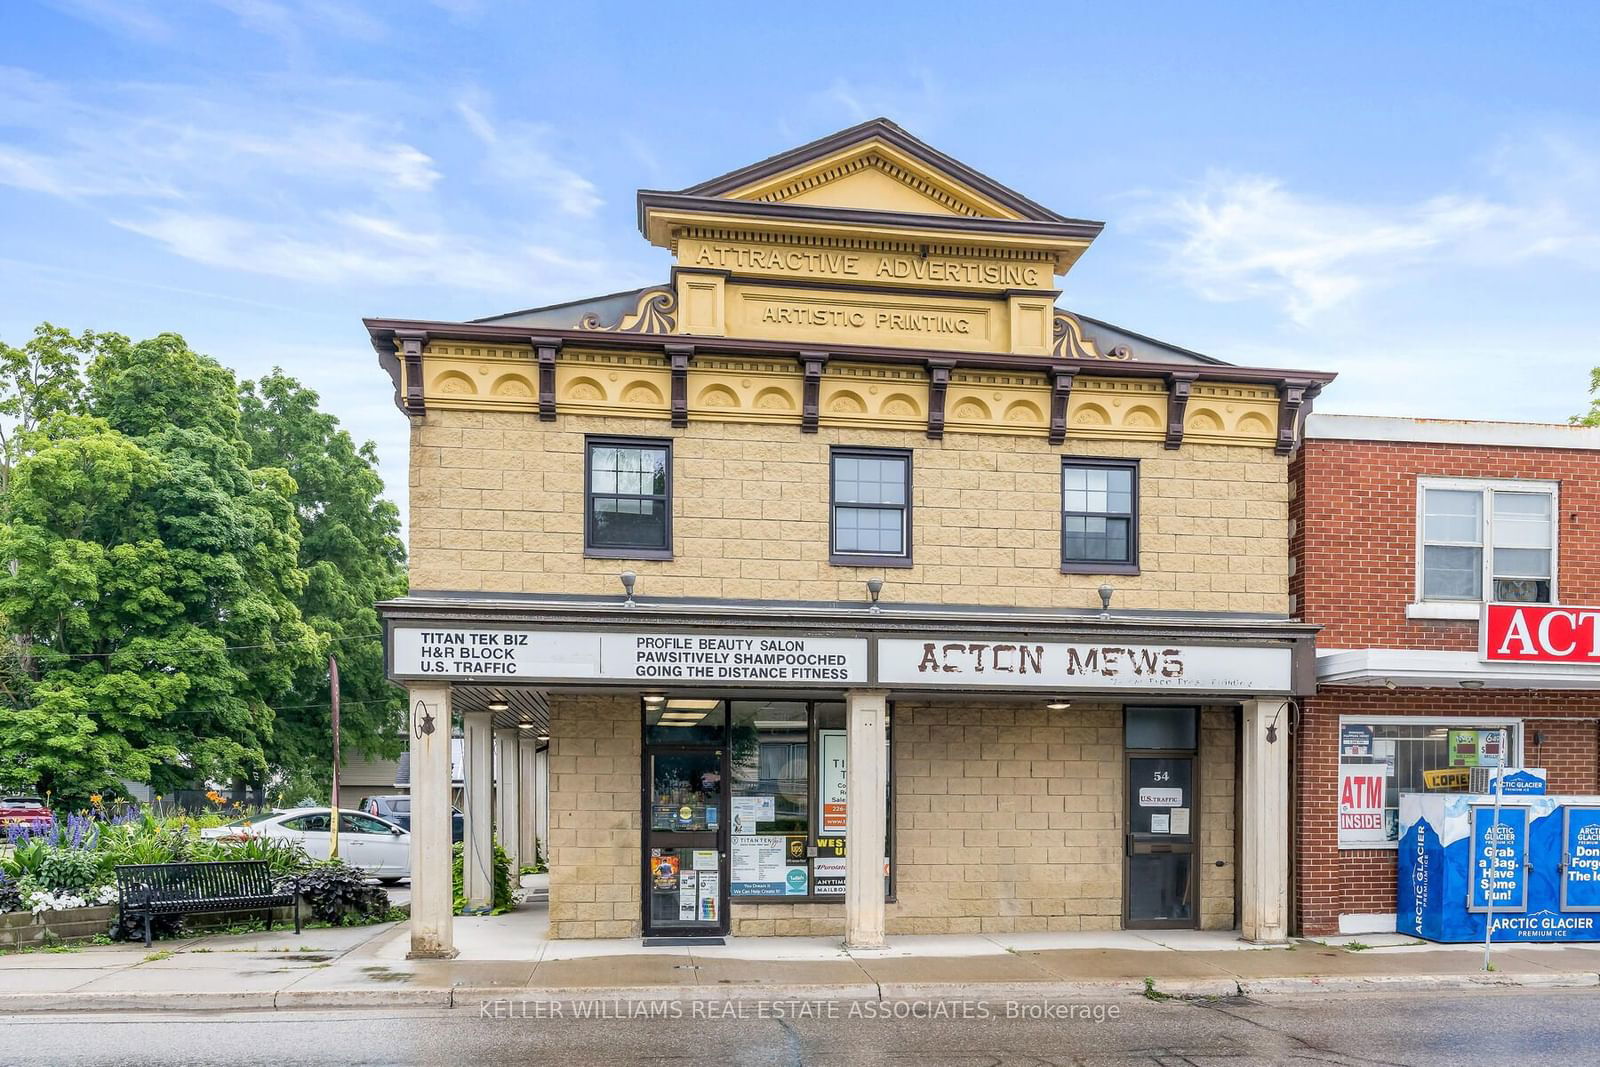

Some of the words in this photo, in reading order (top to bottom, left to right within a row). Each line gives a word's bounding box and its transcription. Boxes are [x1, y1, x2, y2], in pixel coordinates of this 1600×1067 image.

[696, 244, 859, 275] ATTRACTIVE
[876, 257, 1038, 286] ADVERTISING
[762, 306, 865, 328] ARTISTIC
[875, 312, 969, 334] PRINTING
[421, 632, 465, 645] TITAN
[469, 633, 499, 646] TEK
[503, 634, 528, 646] BIZ
[1497, 608, 1600, 657] ACT
[636, 637, 693, 650] PROFILE
[699, 638, 753, 651] BEAUTY
[760, 640, 804, 652] SALON
[421, 646, 455, 658] H&R
[460, 647, 515, 660] BLOCK
[636, 651, 730, 664] PAWSITIVELY
[733, 653, 847, 666] SHAMPOOCHED
[421, 661, 449, 673] U.S.
[453, 661, 517, 674] TRAFFIC
[917, 643, 1044, 674] ACTON
[1066, 647, 1184, 678] MEWS
[635, 665, 682, 677] GOING
[686, 666, 714, 678] THE
[718, 666, 788, 679] DISTANCE
[791, 667, 848, 680] FITNESS
[1153, 771, 1170, 782] 54
[1431, 773, 1469, 787] COPIE
[1492, 781, 1516, 789] ACTIC
[1341, 776, 1382, 809] ATM
[1341, 815, 1381, 829] INSIDE
[1416, 825, 1426, 882] GLACIER
[1484, 847, 1515, 857] Grab
[1479, 859, 1487, 868] a
[1572, 857, 1600, 870] Forg
[1482, 869, 1515, 878] Have
[1568, 870, 1591, 881] The
[1484, 890, 1511, 900] Fun!
[1415, 884, 1424, 935] ARCTIC
[1492, 918, 1538, 929] ARCTIC
[1541, 918, 1593, 929] GLACIER
